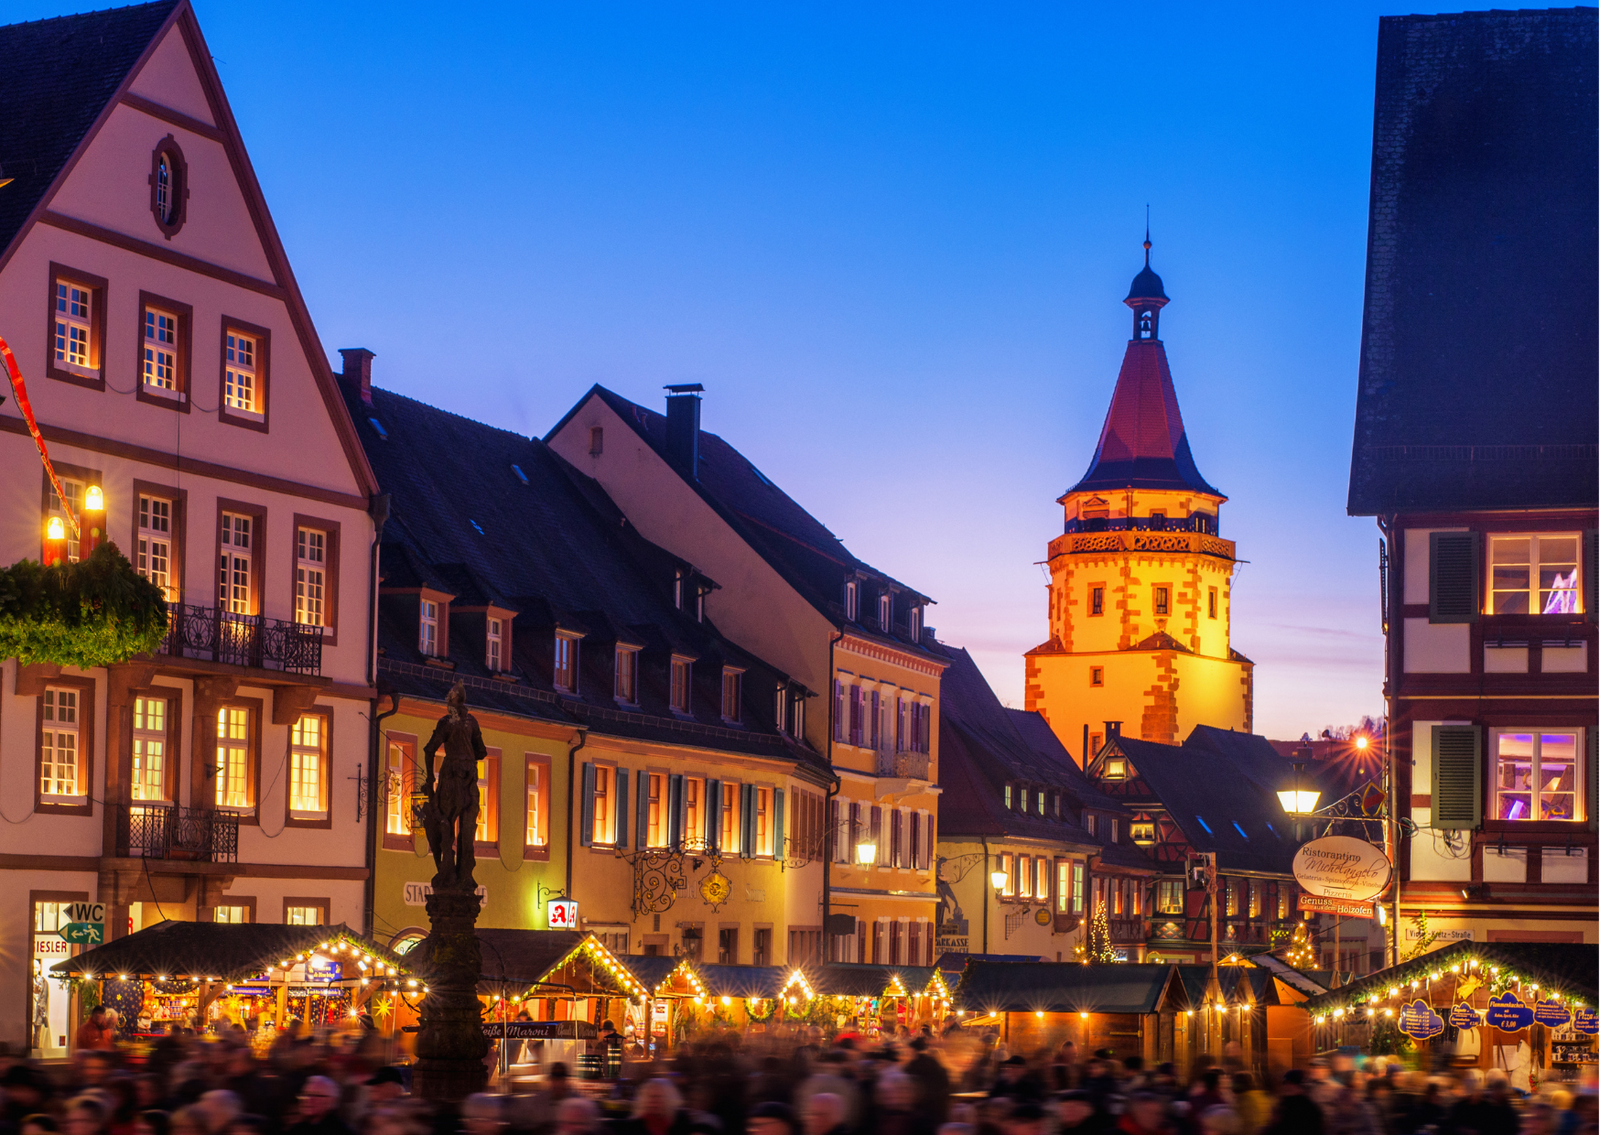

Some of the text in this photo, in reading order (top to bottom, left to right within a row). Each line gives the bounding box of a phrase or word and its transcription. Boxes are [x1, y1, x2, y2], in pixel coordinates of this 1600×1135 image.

[1302, 846, 1361, 862] Ristorantino
[1304, 857, 1387, 890] Michelangelo
[1323, 888, 1352, 898] Pizzeria
[1300, 896, 1332, 905] Genuss
[75, 903, 104, 922] WC
[1337, 905, 1372, 914] Holzofen
[34, 941, 67, 952] IESLER
[480, 1025, 502, 1037] eiße
[506, 1025, 550, 1038] Maroni
